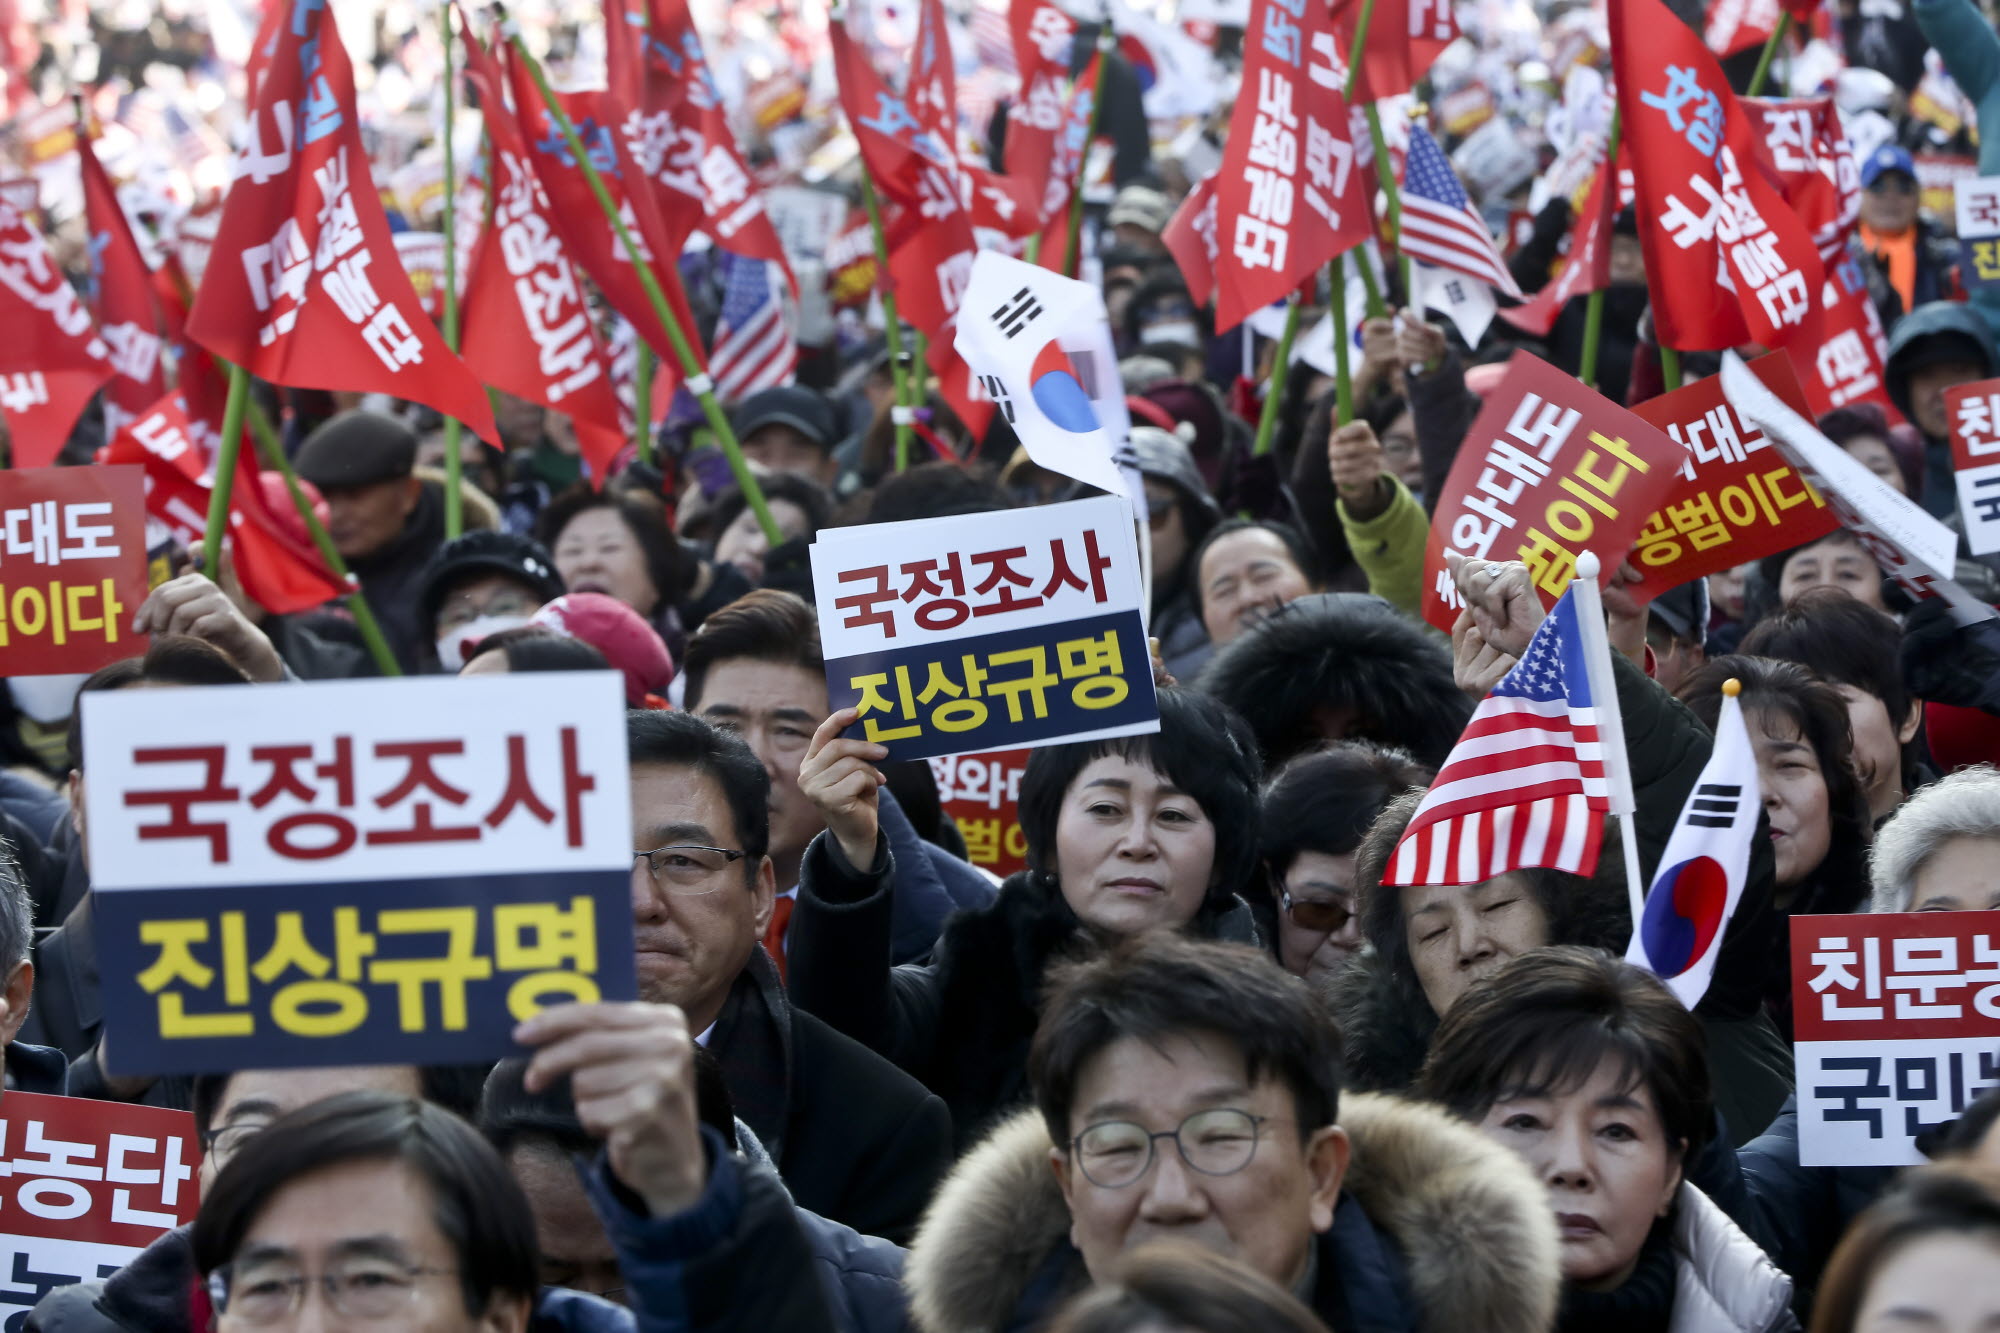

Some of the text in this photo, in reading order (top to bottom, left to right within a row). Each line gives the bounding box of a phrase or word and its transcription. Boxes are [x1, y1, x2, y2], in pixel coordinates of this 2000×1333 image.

[0, 501, 121, 566] 대도
[834, 529, 1112, 639] 국정조사
[0, 578, 123, 646] 이다
[850, 629, 1130, 743] 진상규명
[122, 726, 597, 864] 국정조사
[136, 896, 602, 1040] 진상규명
[0, 1118, 192, 1230] 농단
